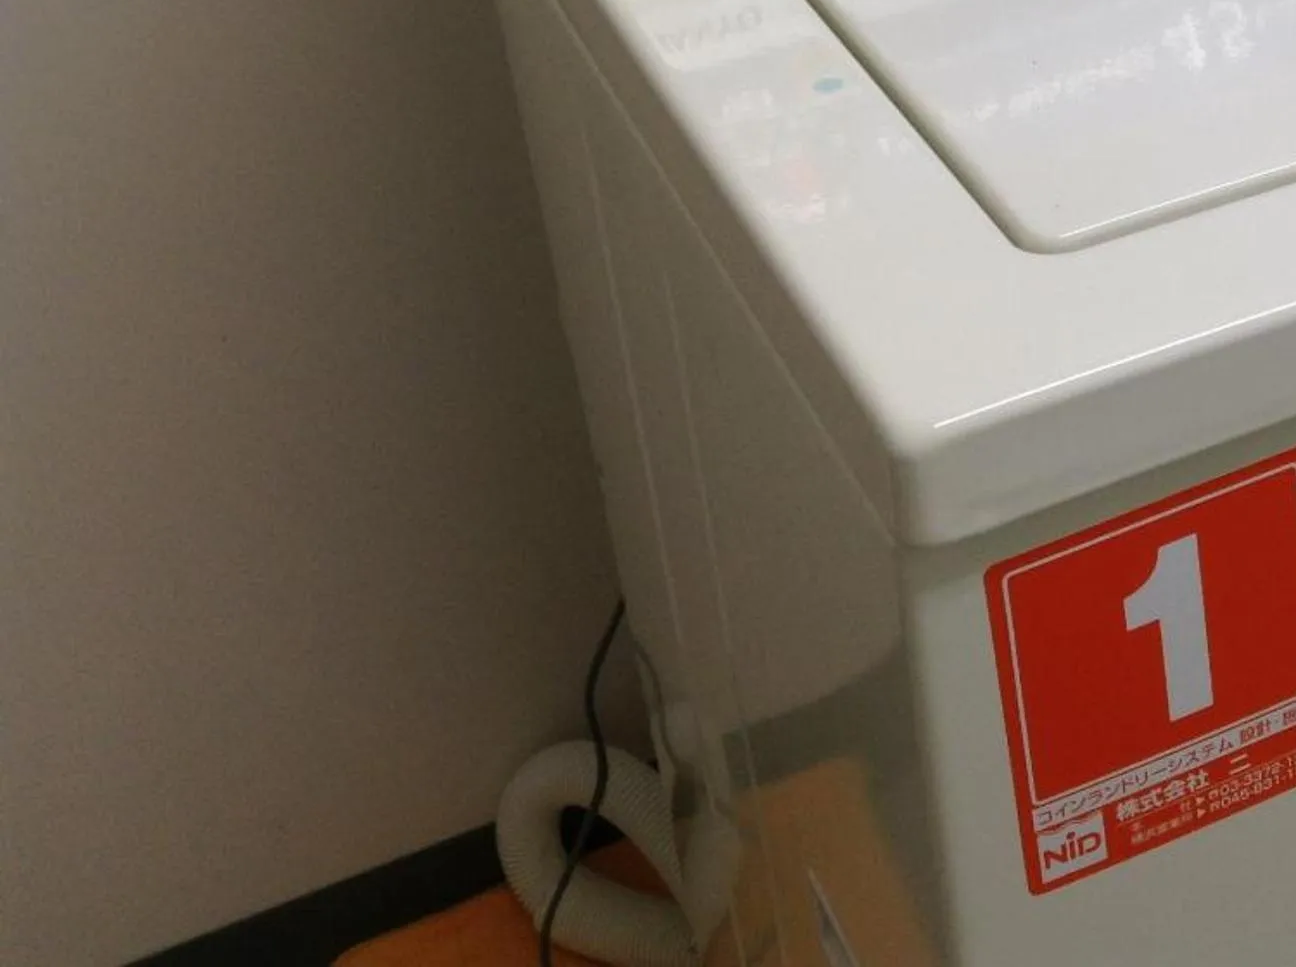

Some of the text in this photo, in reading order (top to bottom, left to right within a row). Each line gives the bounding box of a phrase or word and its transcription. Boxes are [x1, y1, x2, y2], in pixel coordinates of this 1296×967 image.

[1123, 533, 1215, 723] 1
[1115, 768, 1210, 821] 株式会社
